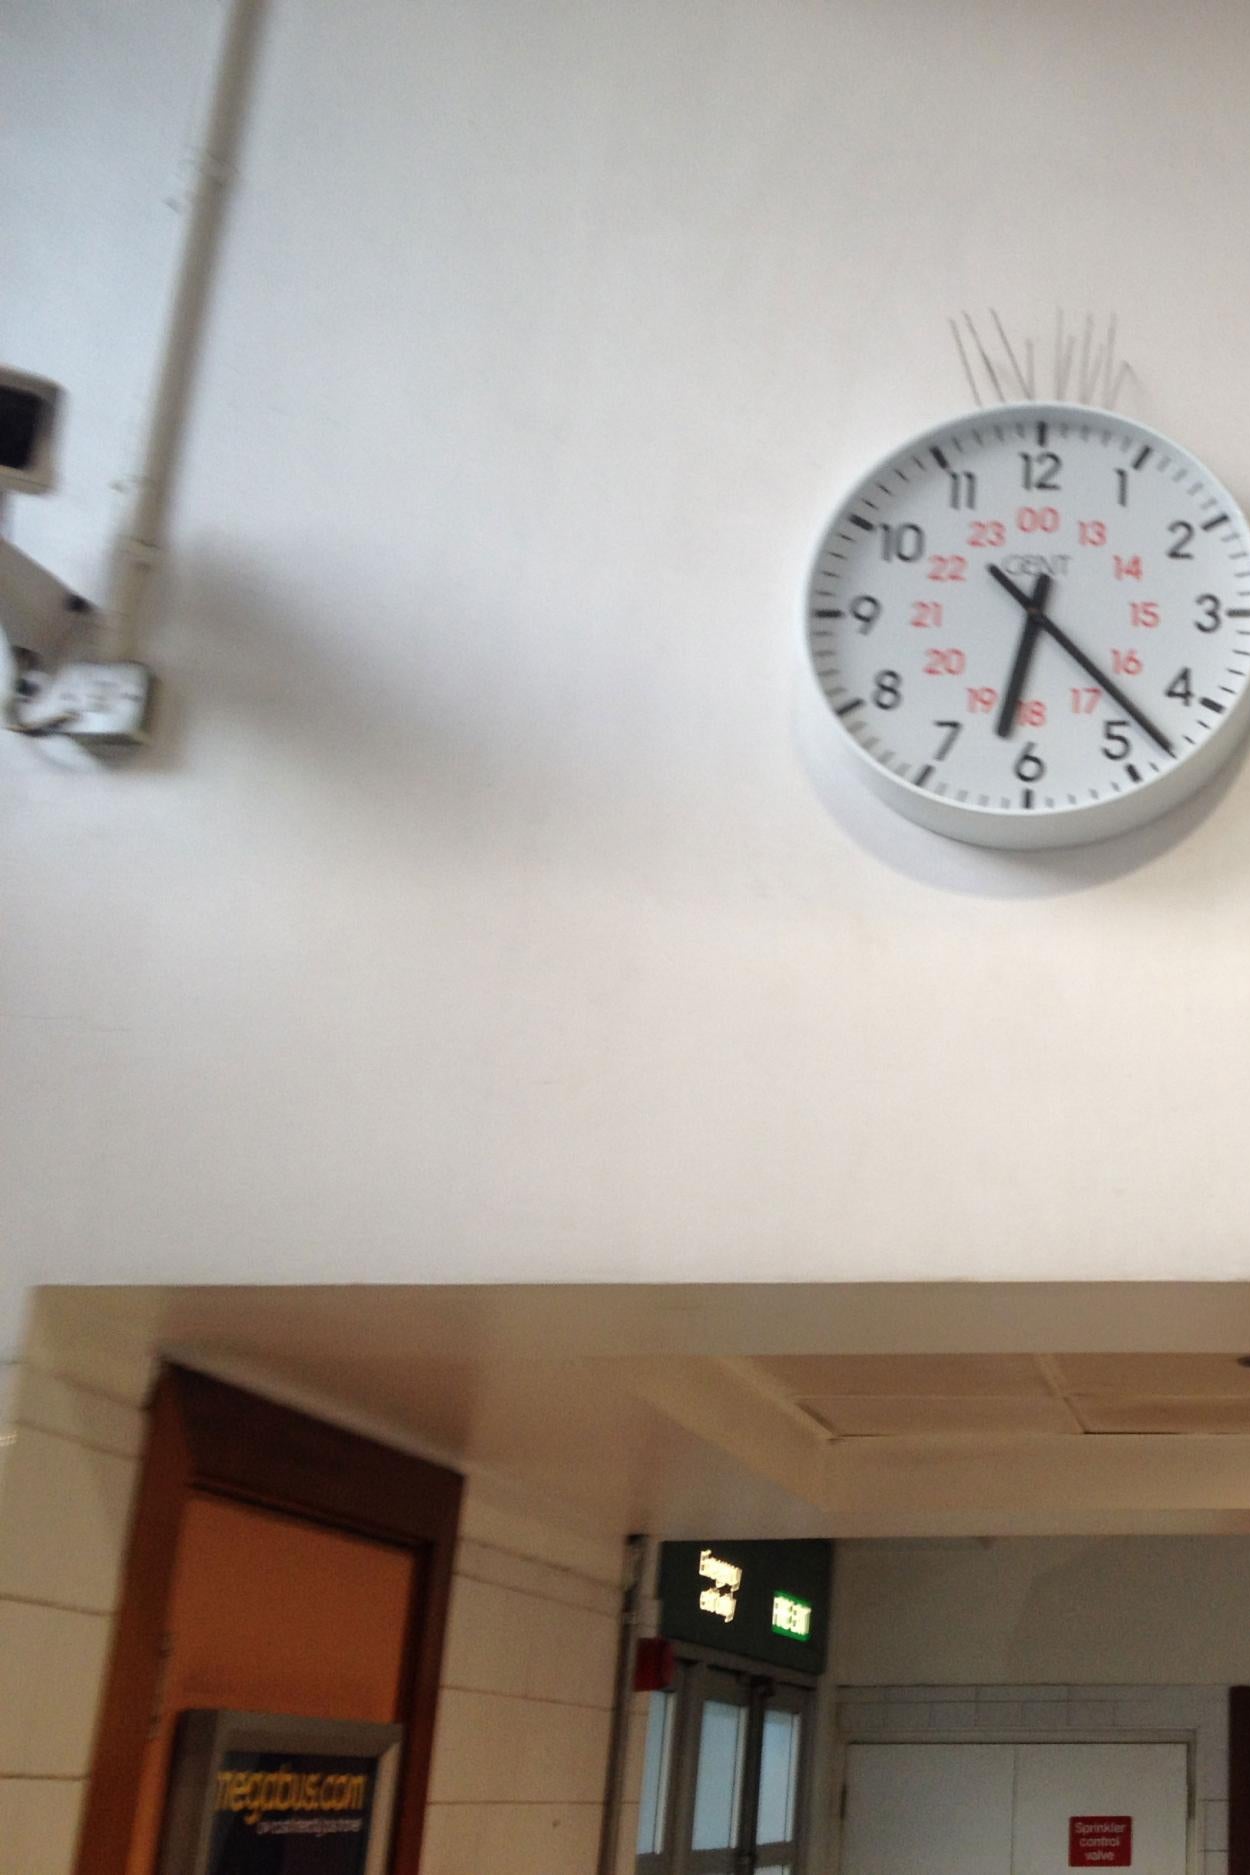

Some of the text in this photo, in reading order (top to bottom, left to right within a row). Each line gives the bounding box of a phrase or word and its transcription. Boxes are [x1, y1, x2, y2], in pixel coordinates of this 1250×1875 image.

[1020, 452, 1061, 491] 12
[948, 471, 977, 509] 11
[1115, 469, 1128, 506] 1
[967, 519, 1006, 547] 23
[1016, 507, 1060, 532] 00
[1077, 520, 1107, 547] 13
[878, 522, 925, 562] 10
[1166, 521, 1195, 560] 2
[927, 555, 968, 582] 22
[1112, 554, 1142, 581] 14
[849, 595, 882, 635] 9
[911, 601, 942, 628] 21
[1129, 601, 1160, 628] 15
[1193, 594, 1222, 632] 3
[924, 648, 966, 676] 20
[1111, 648, 1142, 676] 16
[871, 669, 903, 710] 8
[966, 687, 999, 714] 19
[1070, 687, 1103, 713] 17
[1164, 667, 1194, 707] 4
[1018, 701, 1046, 727] 18
[933, 720, 963, 761] 7
[1102, 720, 1130, 761] 5
[1014, 741, 1046, 783] 6
[1074, 1822, 1125, 1836] Sprinkler
[1080, 1836, 1120, 1847] control
[1085, 1850, 1115, 1861] valve
